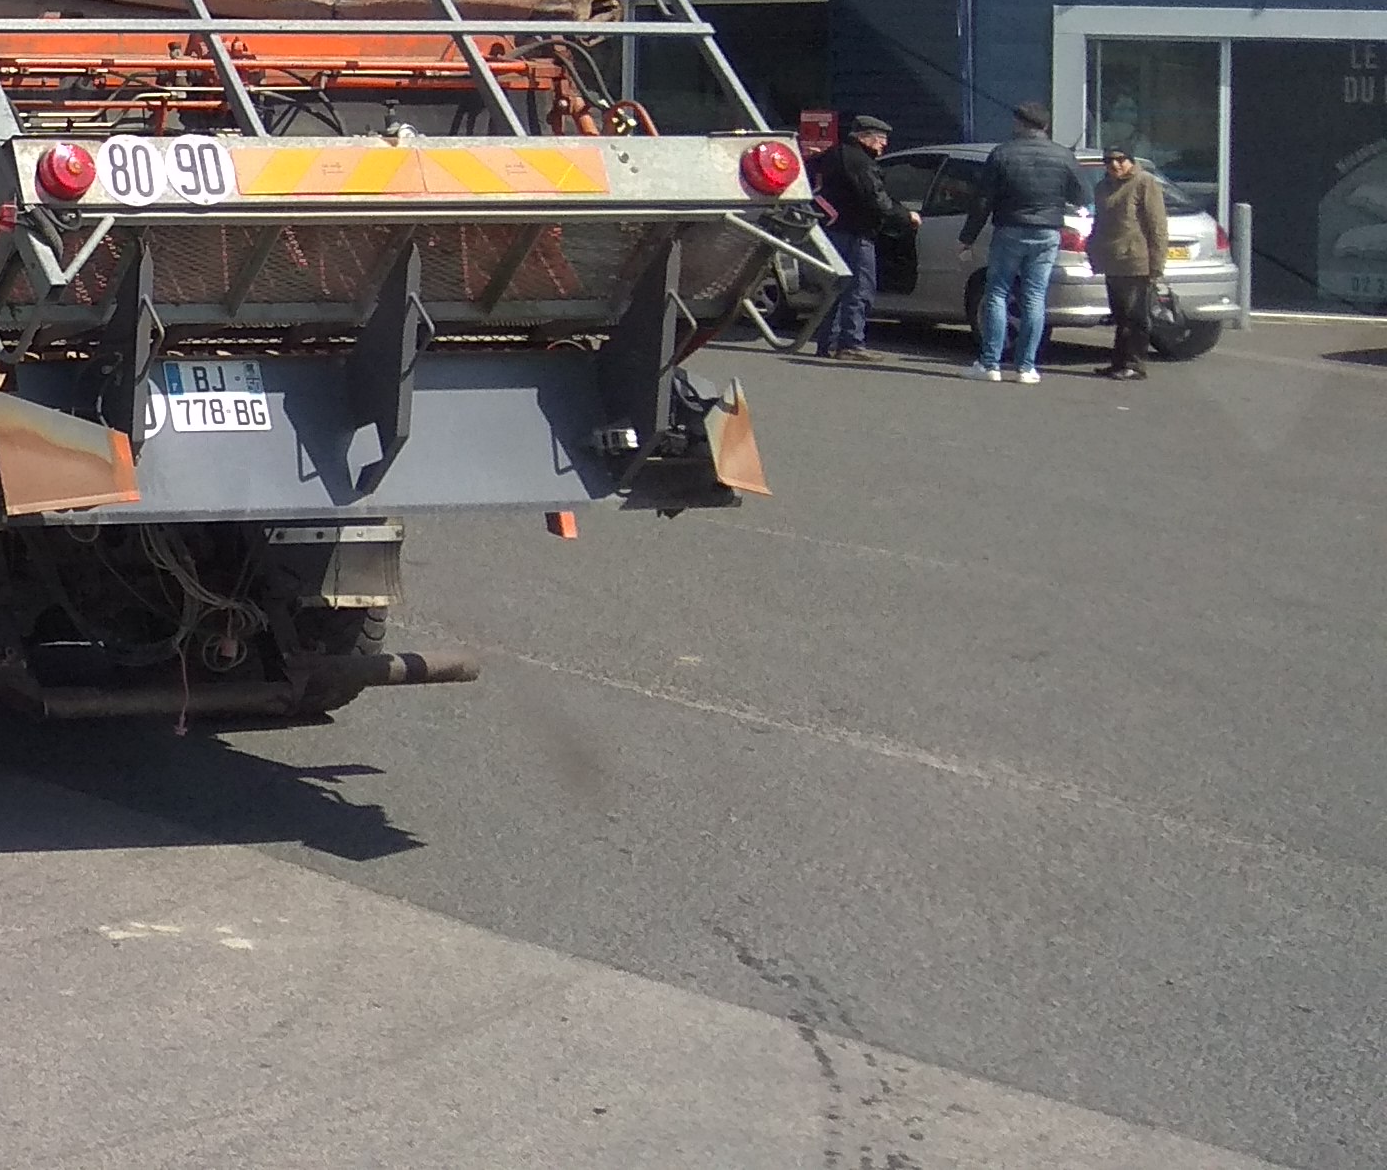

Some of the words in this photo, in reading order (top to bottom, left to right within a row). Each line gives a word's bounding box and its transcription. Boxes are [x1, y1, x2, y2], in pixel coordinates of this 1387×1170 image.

[108, 143, 154, 197] 80
[174, 143, 225, 195] 90
[192, 366, 226, 392] BJ
